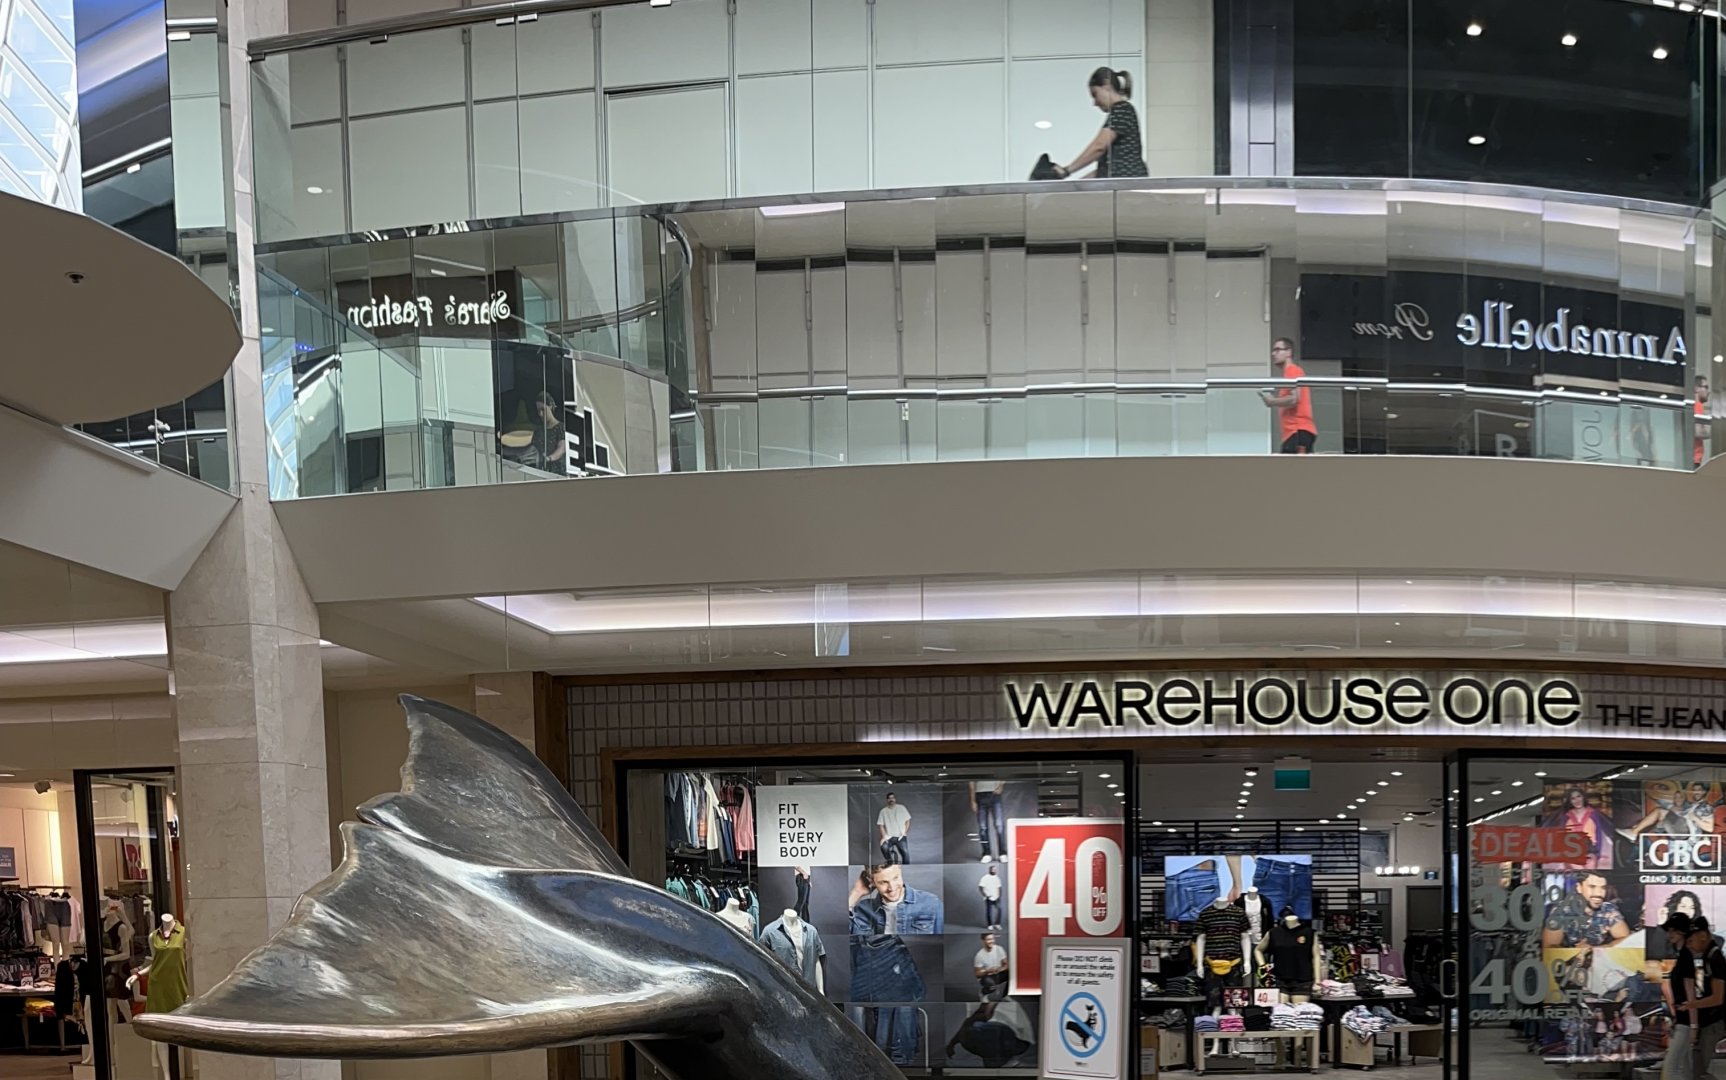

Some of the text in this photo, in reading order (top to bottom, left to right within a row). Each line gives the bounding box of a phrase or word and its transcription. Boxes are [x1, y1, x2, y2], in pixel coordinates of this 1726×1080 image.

[1596, 704, 1654, 727] THE
[1659, 706, 1726, 731] JEAN
[778, 803, 799, 815] FIT
[779, 817, 806, 829] FOR
[780, 831, 823, 843] EVERY
[780, 846, 817, 858] BODY
[1478, 832, 1584, 860] DEALS
[1649, 838, 1713, 867] GBC
[1639, 874, 1721, 884] GRAND BEACH CLUB
[1019, 836, 1122, 936] 40
[1469, 1008, 1542, 1021] ORIGINAL
